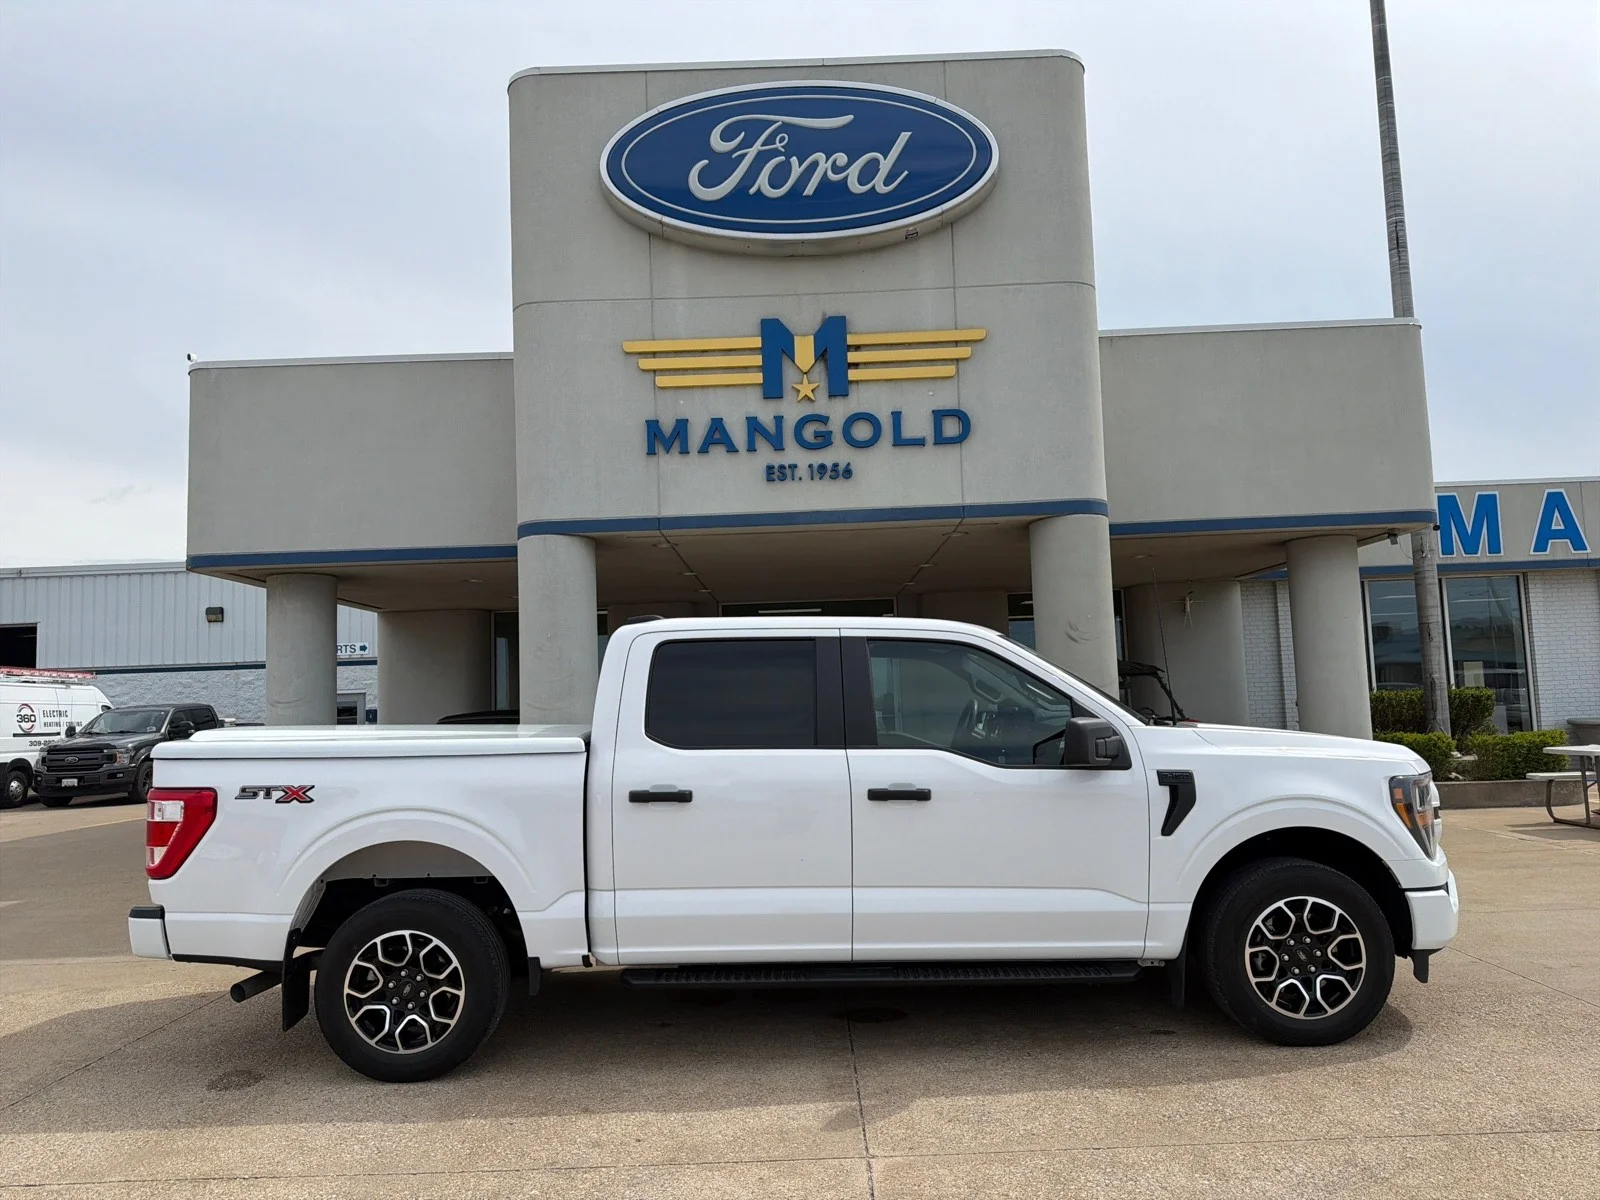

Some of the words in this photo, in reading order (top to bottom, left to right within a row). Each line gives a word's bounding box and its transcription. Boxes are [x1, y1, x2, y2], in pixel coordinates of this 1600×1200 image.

[688, 113, 912, 201] Ford
[645, 408, 971, 456] MANGOLD
[765, 463, 802, 482] EST.
[808, 462, 853, 481] 1956
[16, 713, 37, 724] 360
[42, 709, 68, 718] ELECTRIC
[234, 784, 316, 804] STX
